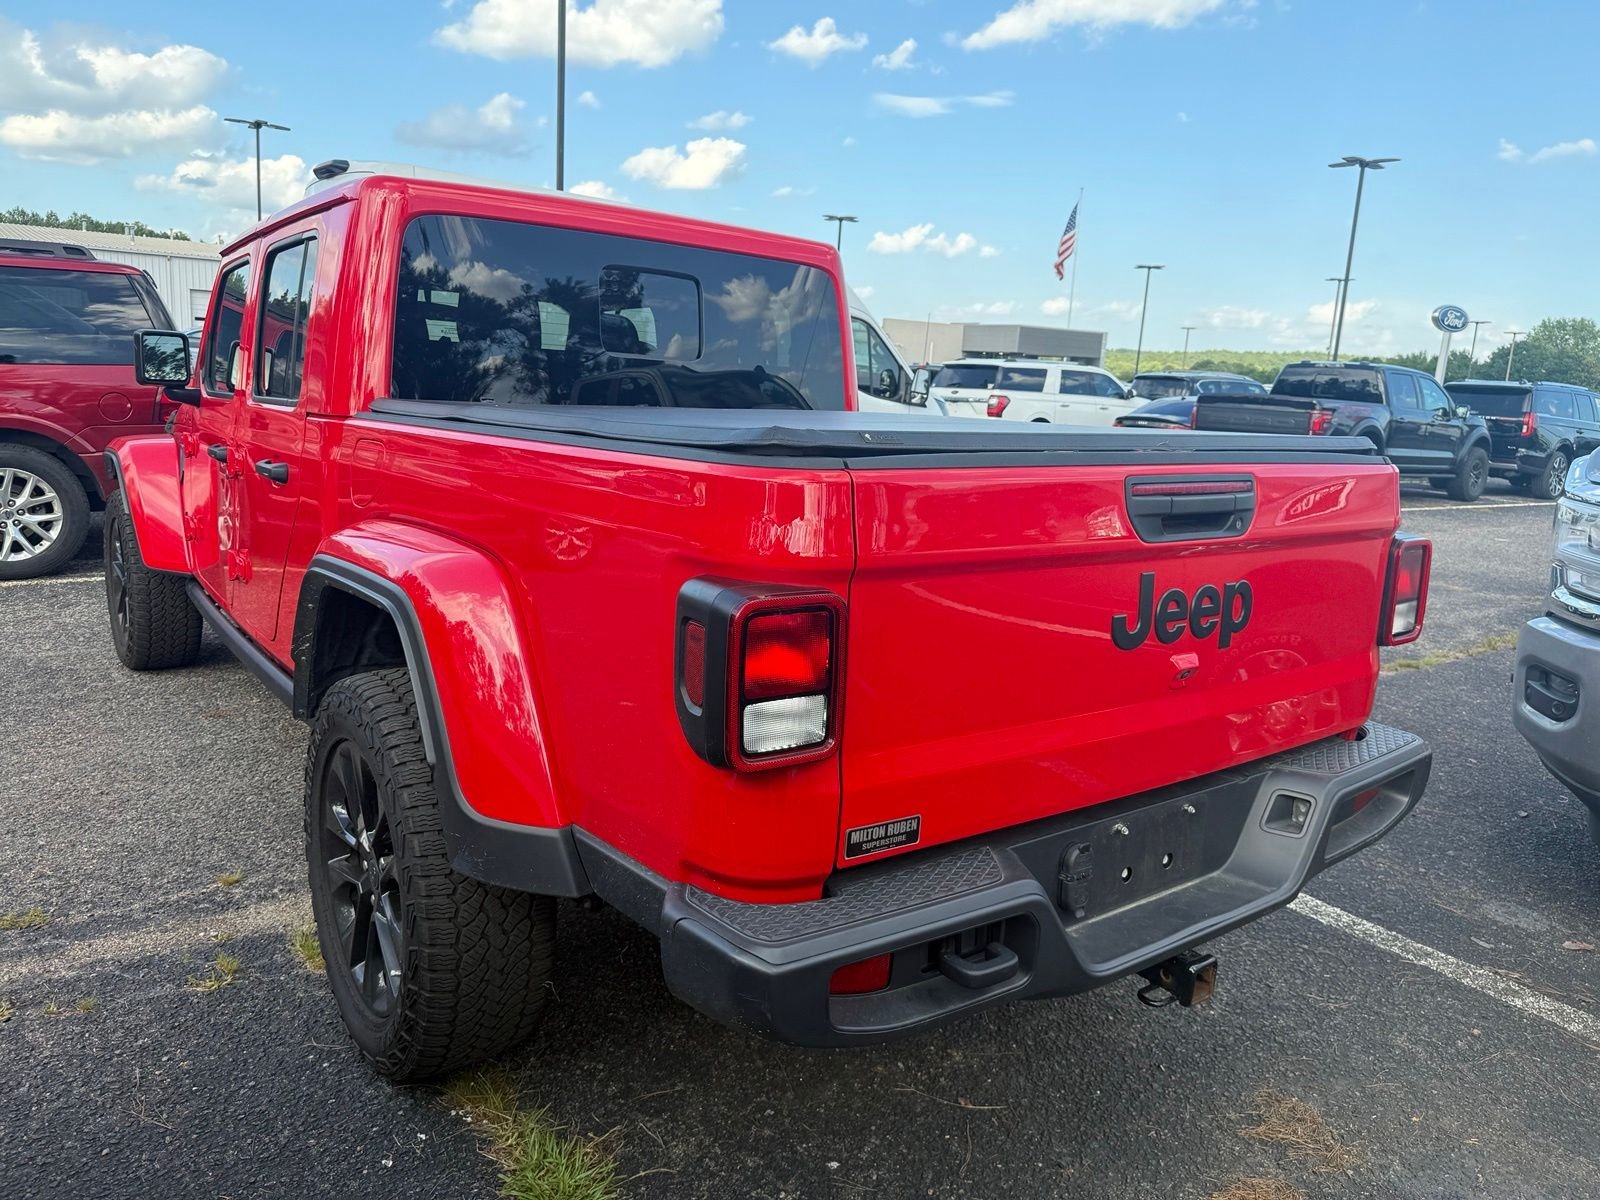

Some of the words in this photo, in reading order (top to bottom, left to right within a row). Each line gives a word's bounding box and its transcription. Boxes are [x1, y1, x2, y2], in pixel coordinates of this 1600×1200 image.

[1444, 310, 1465, 328] Ford
[1111, 571, 1253, 650] Jeep
[850, 825, 886, 844] MILTON
[887, 818, 918, 836] RUBEN
[862, 834, 907, 850] SUPERSTORE
